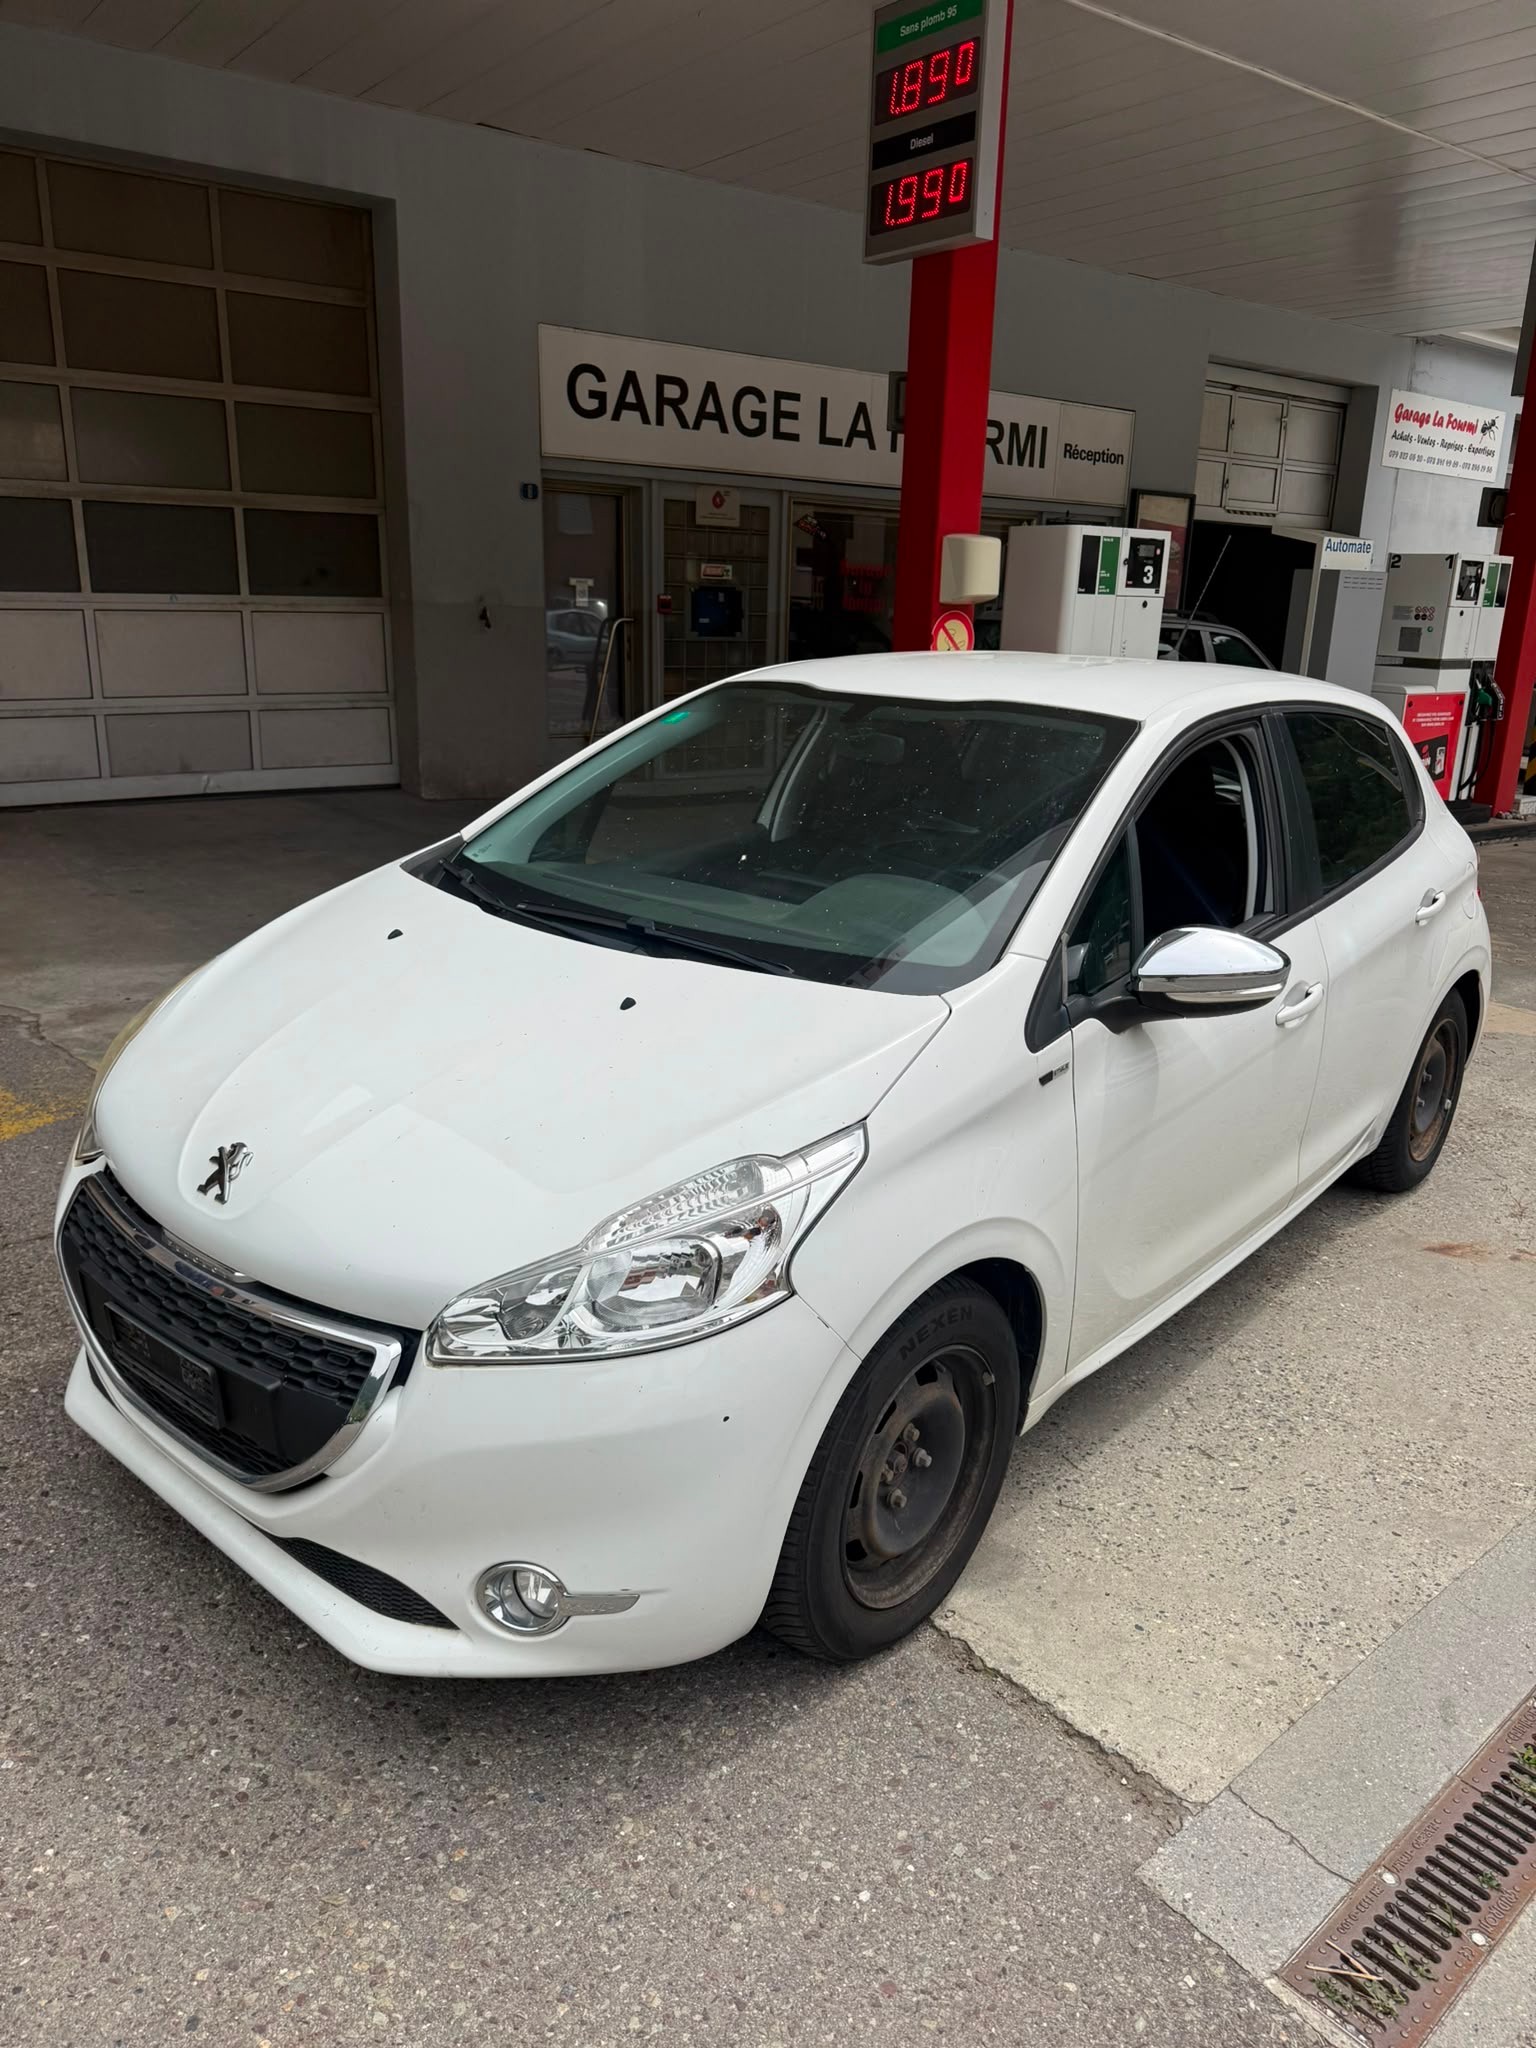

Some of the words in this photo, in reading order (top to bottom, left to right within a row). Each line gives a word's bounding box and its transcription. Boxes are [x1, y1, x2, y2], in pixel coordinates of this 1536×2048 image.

[900, 22, 919, 37] Sans
[920, 10, 946, 32] plomb
[947, 4, 958, 18] 95
[910, 132, 934, 150] Diesel
[566, 363, 801, 442] GARAGE
[818, 396, 876, 451] LA
[1394, 402, 1431, 429] Garage
[1432, 410, 1445, 428] La
[1445, 413, 1479, 436] Fourmi
[1063, 442, 1124, 465] Réception
[1391, 429, 1414, 444] Achats
[1416, 434, 1436, 448] Ventes
[1440, 438, 1464, 453] Reprises
[1467, 443, 1496, 458] Expertises
[1325, 538, 1371, 554] Automate
[1390, 554, 1402, 569] 2
[1445, 554, 1455, 569] 1
[1143, 565, 1154, 584] 3
[1469, 583, 1476, 598] 1
[901, 1304, 972, 1361] NEXEN
